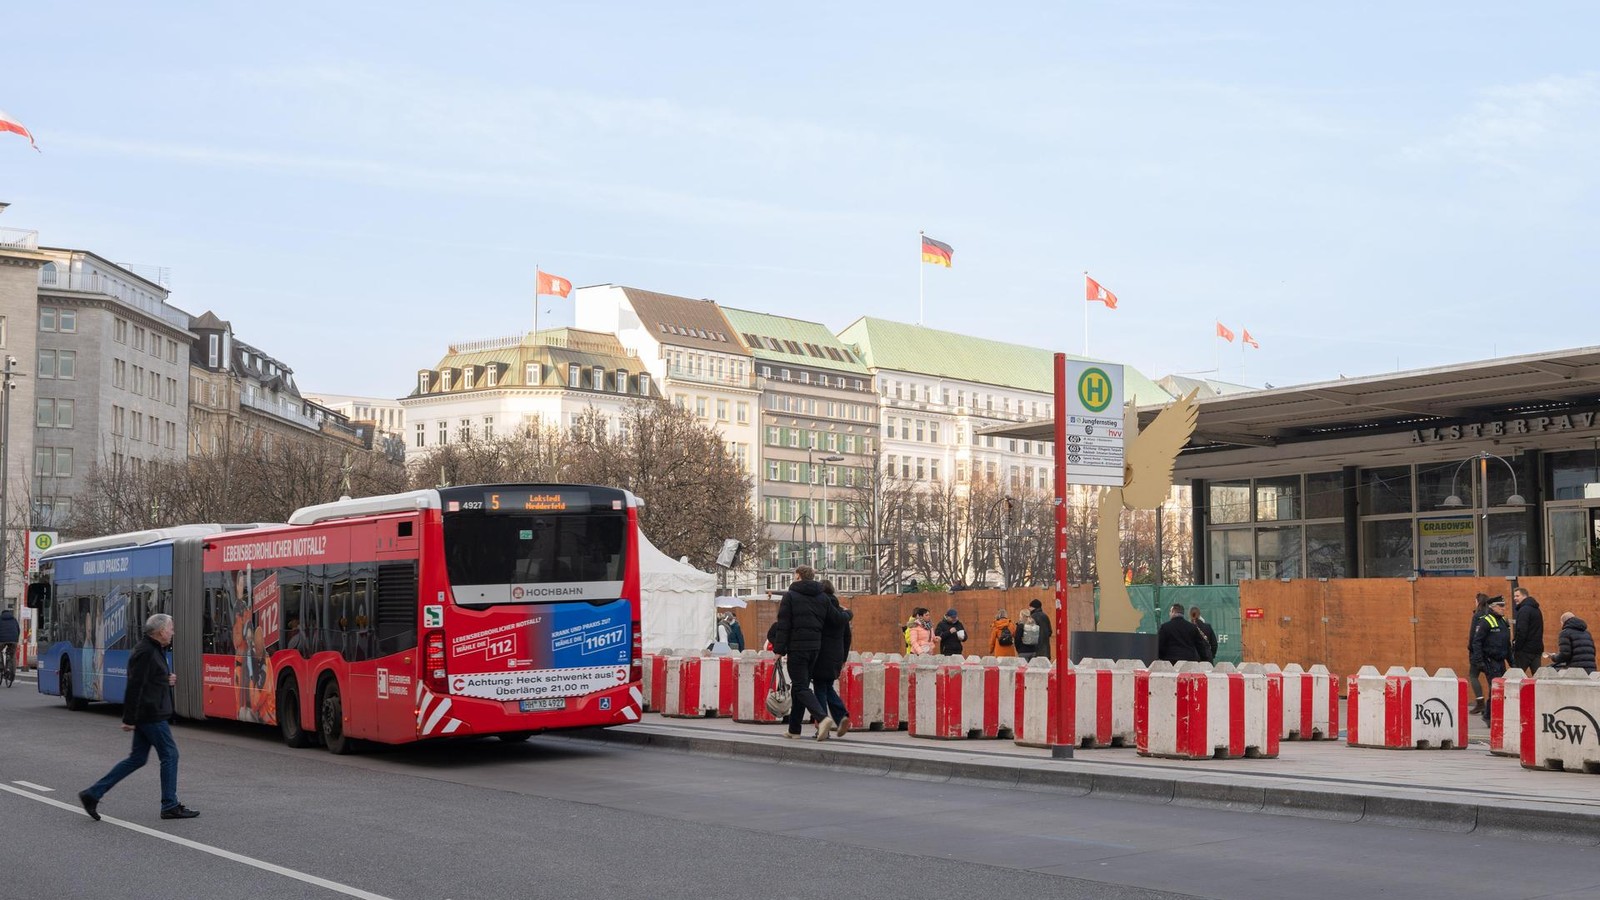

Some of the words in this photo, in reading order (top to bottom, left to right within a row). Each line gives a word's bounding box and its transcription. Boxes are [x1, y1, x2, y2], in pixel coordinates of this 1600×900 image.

[1086, 377, 1103, 402] H
[1082, 418, 1117, 427] Jungfernstieg
[1108, 429, 1122, 437] hvv
[463, 502, 482, 510] 4927
[492, 495, 500, 510] 5
[223, 541, 292, 562] LEBENSBEDROHLICHER
[293, 536, 326, 554] NOTFALL?
[526, 588, 583, 596] HOCHBAHN
[261, 602, 278, 638] 112
[452, 623, 516, 644] LEBENSBEDROHLICHER
[516, 616, 542, 629] NOTFALL?
[552, 630, 570, 638] KRANK
[582, 620, 600, 631] PRAXIS
[456, 644, 476, 653] WÄHLE
[476, 640, 486, 648] DIE
[490, 640, 512, 656] 112
[555, 638, 574, 648] WÄHLE
[586, 630, 622, 650] 116117
[468, 678, 514, 688] Achtung:
[516, 676, 541, 685] Heck
[544, 673, 592, 683] schwenkt
[595, 672, 614, 680] aus!
[496, 686, 548, 696] Überlänge
[551, 684, 578, 692] 21,00
[548, 700, 565, 708] 4927
[1415, 704, 1443, 728] RSW
[1542, 714, 1586, 745] RSW
